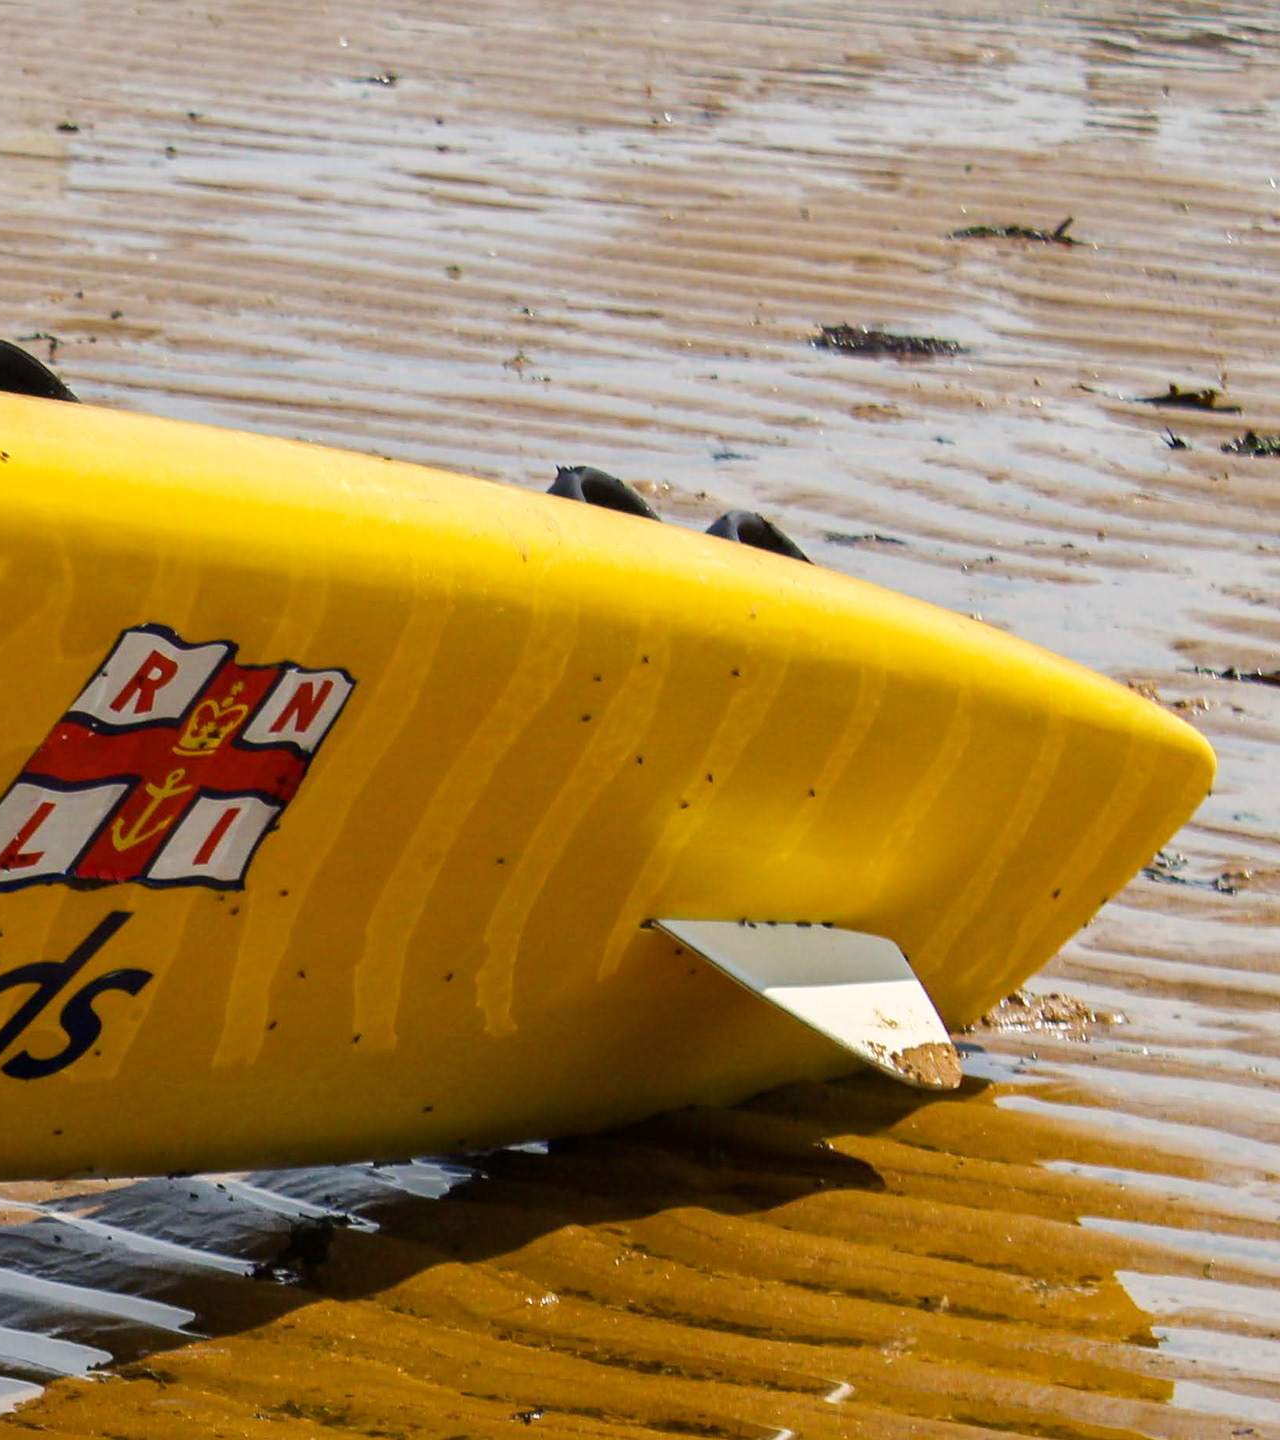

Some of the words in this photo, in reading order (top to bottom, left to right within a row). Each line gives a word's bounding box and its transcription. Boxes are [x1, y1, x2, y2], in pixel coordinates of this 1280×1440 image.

[108, 649, 179, 715] R
[267, 679, 334, 734] N
[192, 807, 242, 866] I
